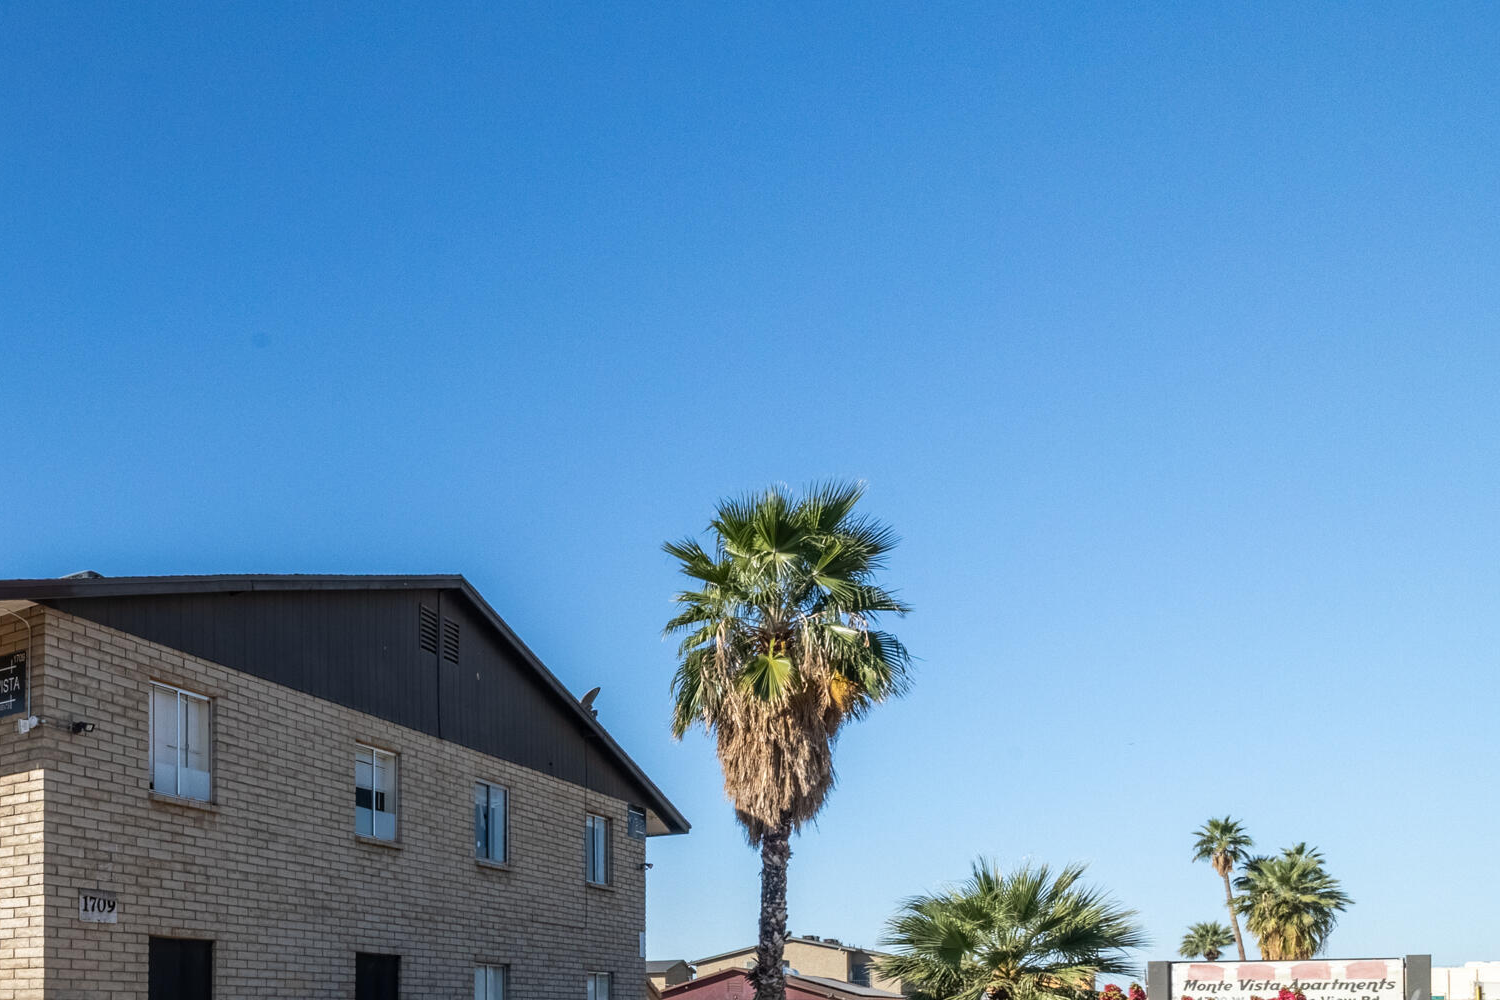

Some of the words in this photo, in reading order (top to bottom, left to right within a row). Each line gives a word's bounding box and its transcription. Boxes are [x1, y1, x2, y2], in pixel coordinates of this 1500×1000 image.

[83, 896, 116, 913] 1709
[1183, 979, 1233, 993] Monte
[1238, 979, 1280, 991] Vista
[1289, 978, 1396, 993] Apartments
